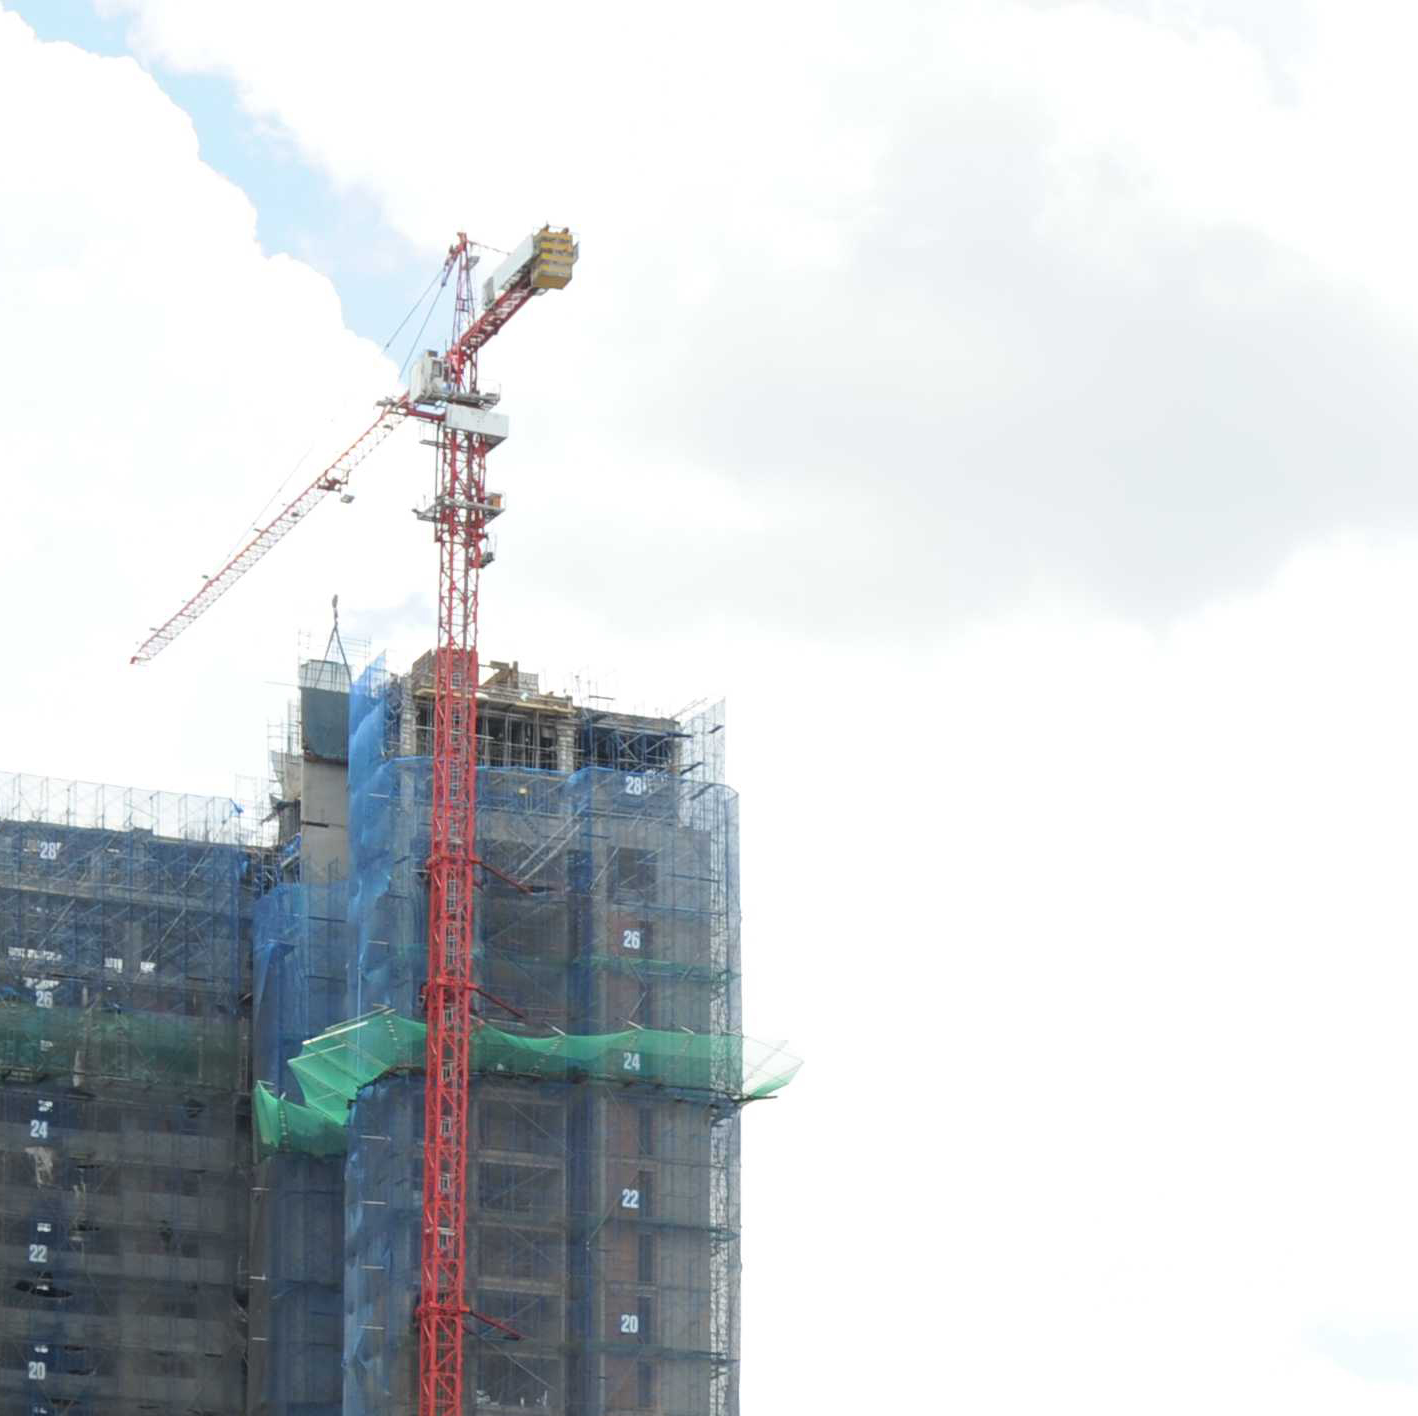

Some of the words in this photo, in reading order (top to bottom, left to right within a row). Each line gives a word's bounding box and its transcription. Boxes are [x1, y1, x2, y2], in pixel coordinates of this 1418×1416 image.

[625, 775, 642, 795] 28
[622, 929, 641, 950] 26
[34, 985, 54, 1009] 26
[623, 1051, 641, 1071] 24
[29, 1119, 49, 1140] 24
[621, 1188, 640, 1209] 22
[28, 1243, 48, 1263] 22
[620, 1314, 639, 1334] 20
[28, 1360, 47, 1381] 20
